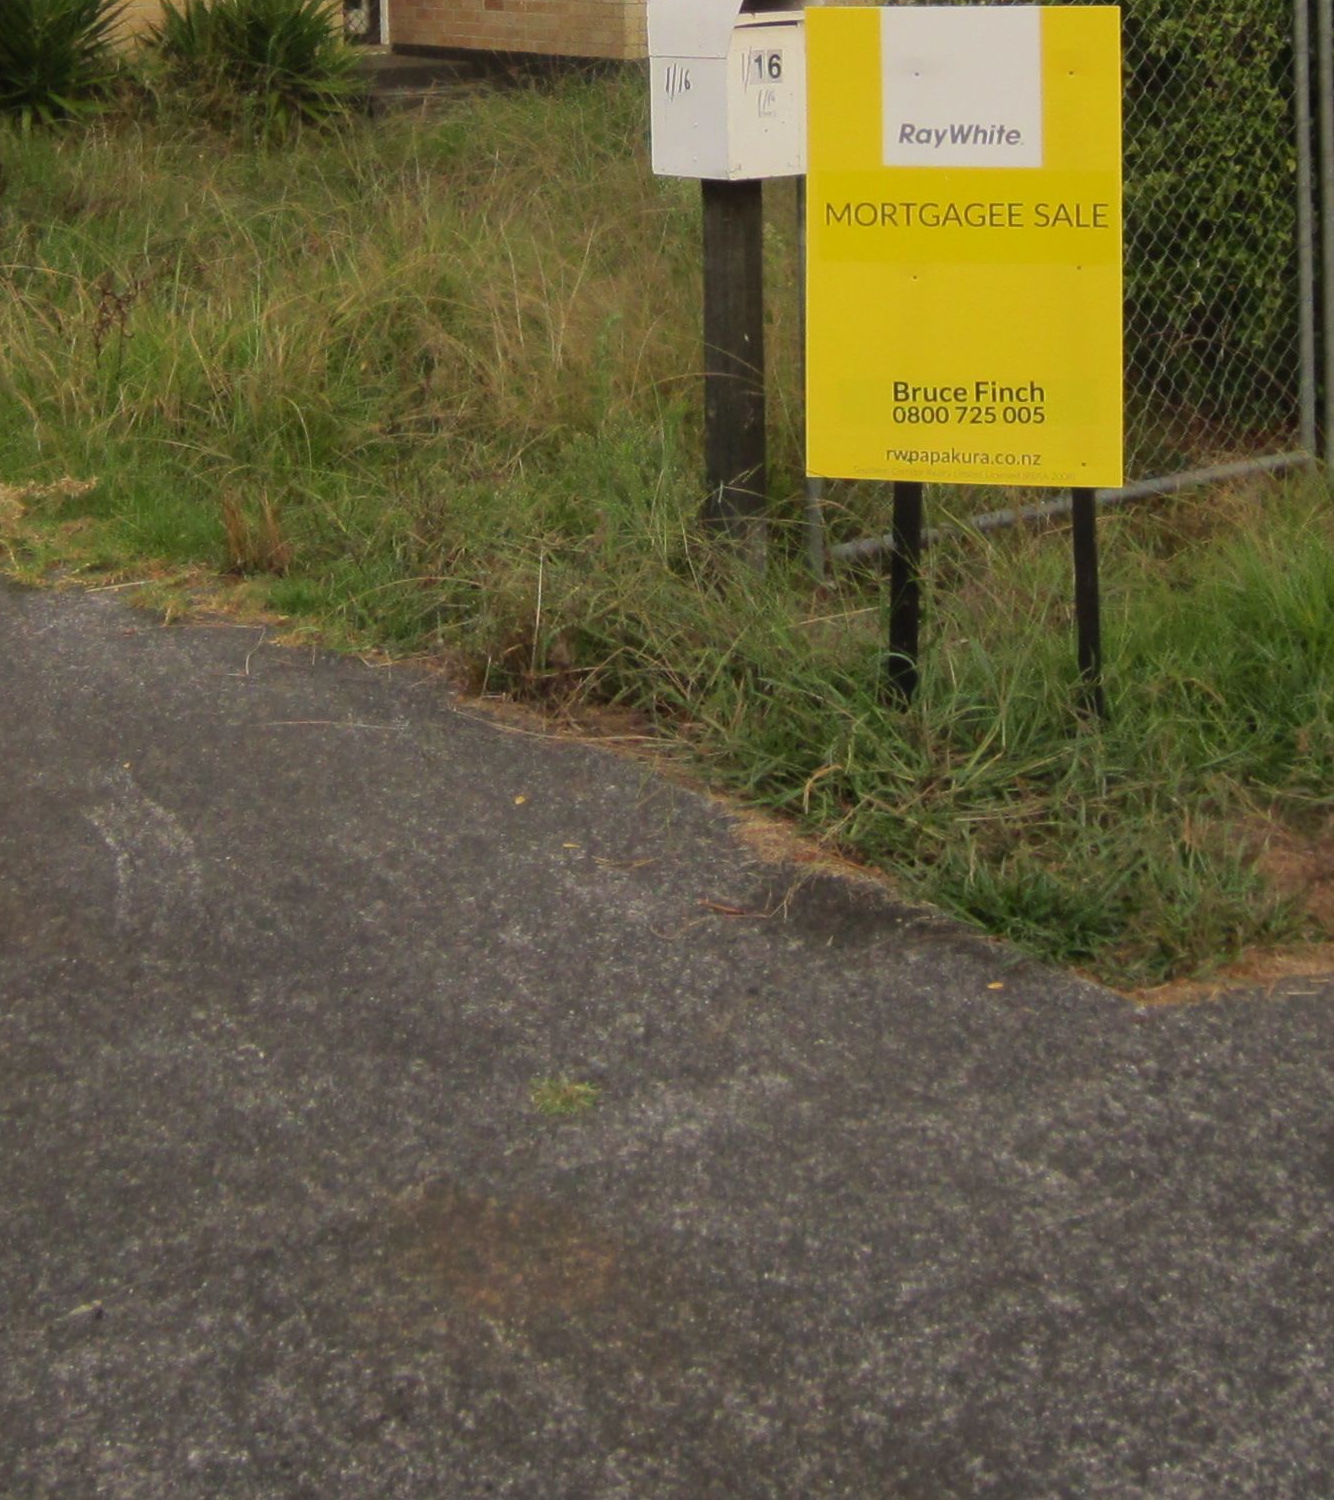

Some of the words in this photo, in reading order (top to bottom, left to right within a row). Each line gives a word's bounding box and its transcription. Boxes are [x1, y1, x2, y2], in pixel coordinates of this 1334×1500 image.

[825, 202, 1023, 227] MORTGAGEE
[1033, 203, 1109, 228] SALE
[893, 381, 967, 402] Bruce
[975, 381, 1045, 402] Finch
[892, 406, 949, 424] 0800
[955, 406, 997, 424] 725
[1002, 406, 1045, 424] 005
[886, 448, 1042, 466] rwpapakura.co.nz
